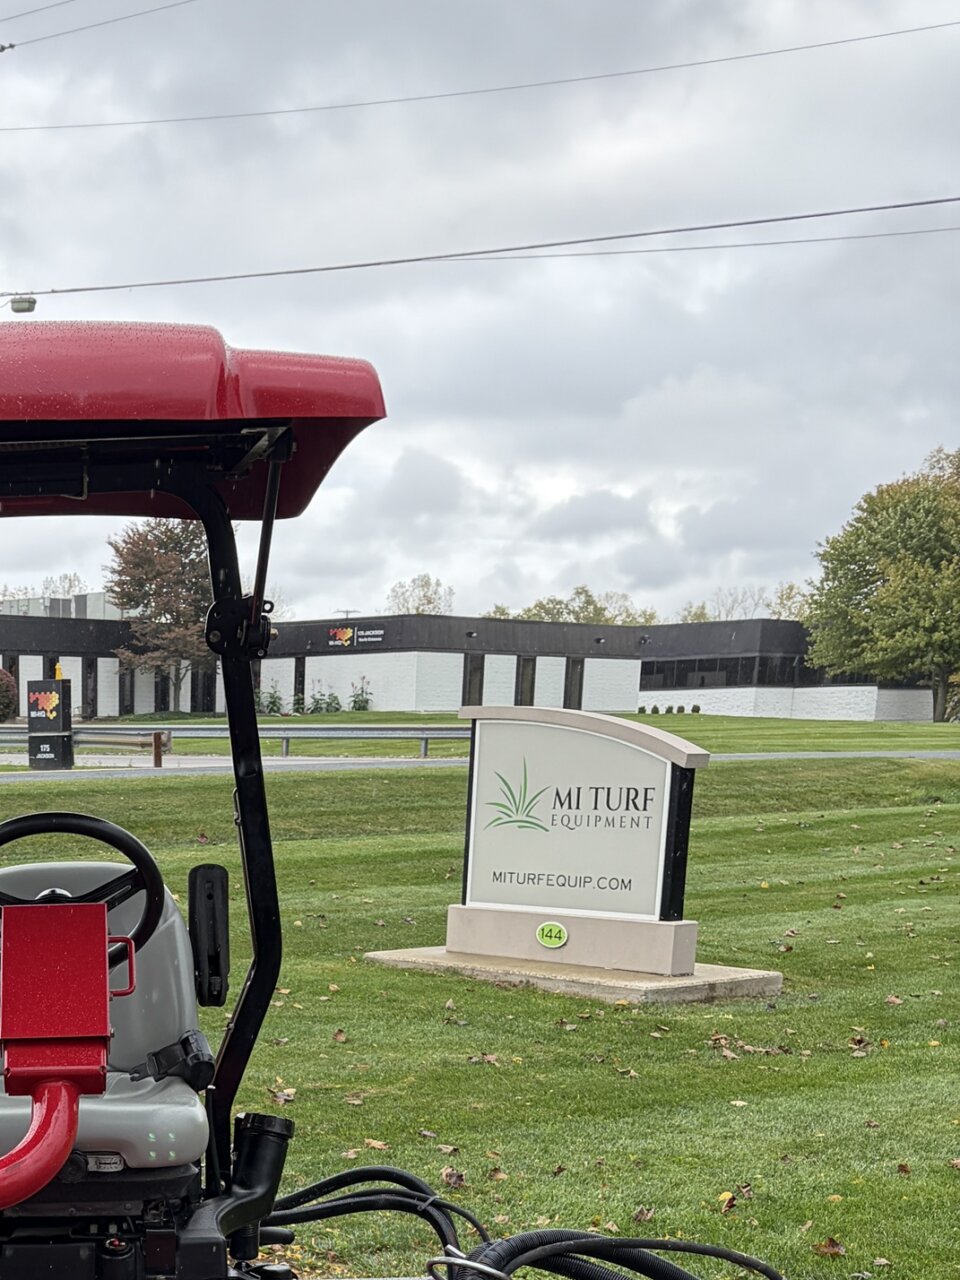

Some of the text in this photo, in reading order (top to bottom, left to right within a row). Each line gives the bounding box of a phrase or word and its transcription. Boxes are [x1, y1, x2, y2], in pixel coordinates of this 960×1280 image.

[40, 744, 50, 752] 175
[552, 786, 656, 812] MI TURF
[551, 814, 653, 831] EQUIPMENT
[492, 871, 632, 891] MITURFEQUIP.COM
[541, 928, 562, 941] 144
